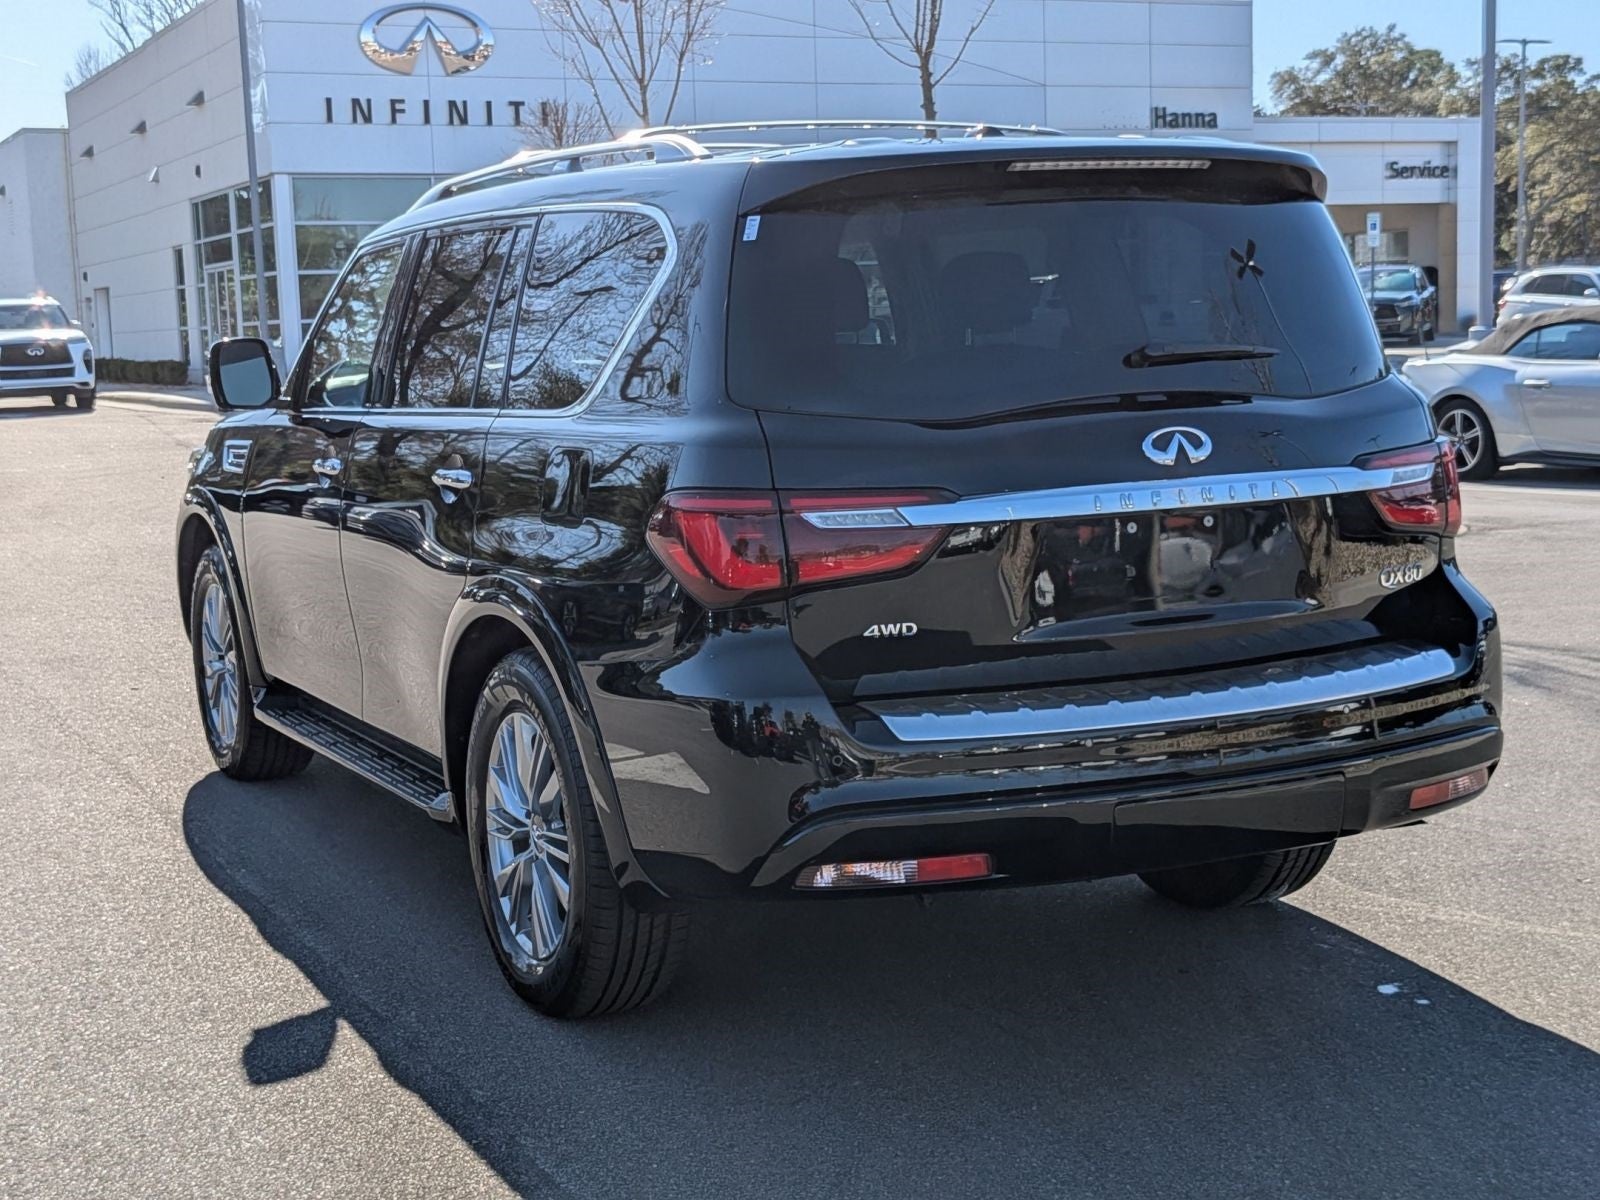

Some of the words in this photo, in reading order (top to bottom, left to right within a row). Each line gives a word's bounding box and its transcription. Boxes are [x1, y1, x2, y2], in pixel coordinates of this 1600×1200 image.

[324, 96, 550, 127] INFINITI
[1151, 106, 1218, 129] Hanna
[1384, 160, 1450, 180] Service
[1093, 480, 1282, 512] INFINITI
[1379, 563, 1422, 589] QX80
[863, 622, 918, 639] 4WD
